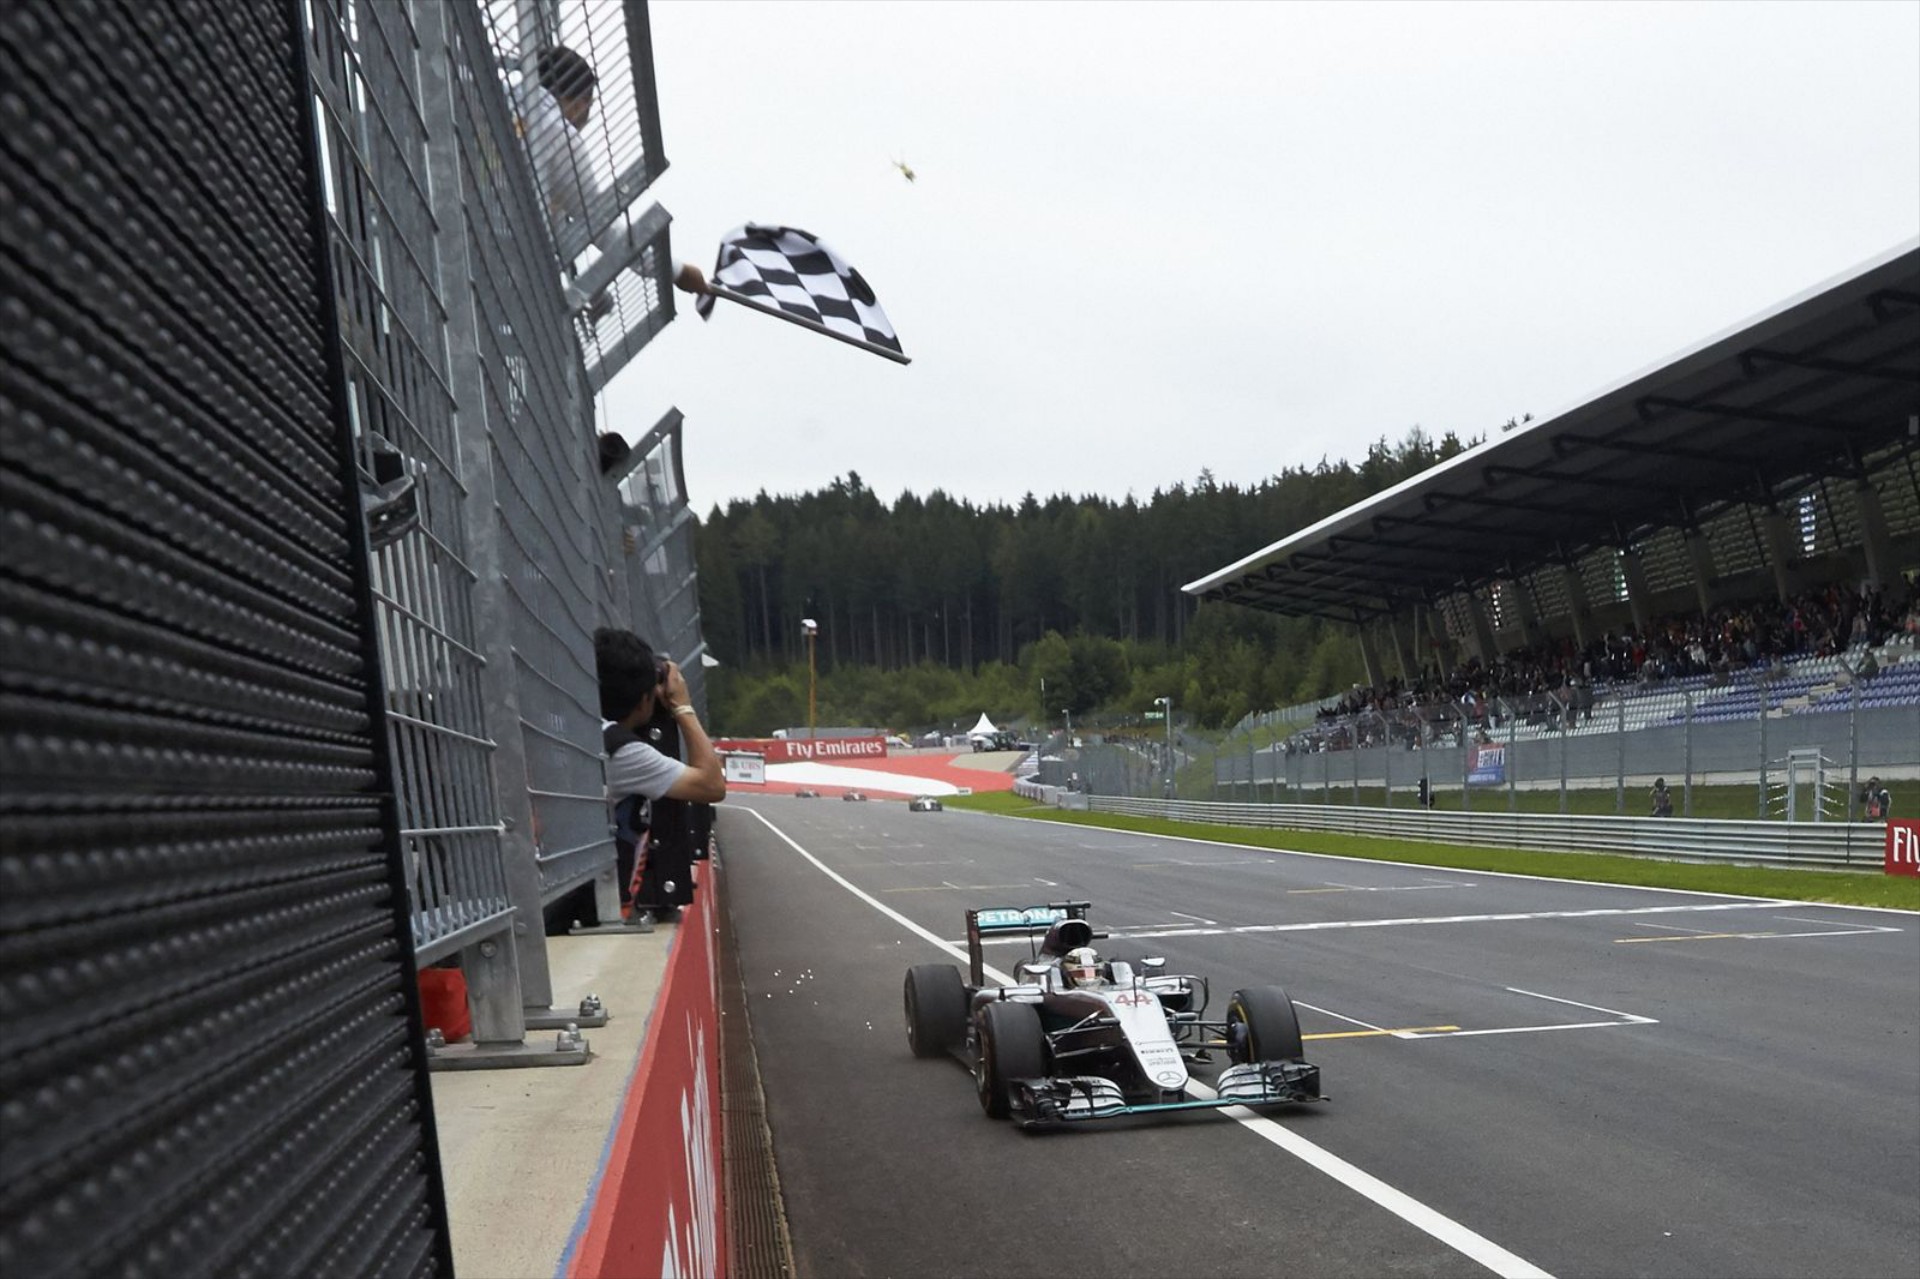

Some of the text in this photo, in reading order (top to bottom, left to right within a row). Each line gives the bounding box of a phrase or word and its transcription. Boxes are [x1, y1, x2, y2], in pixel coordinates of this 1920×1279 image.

[786, 740, 883, 758] Fly Emirates
[1115, 994, 1153, 1006] 44
